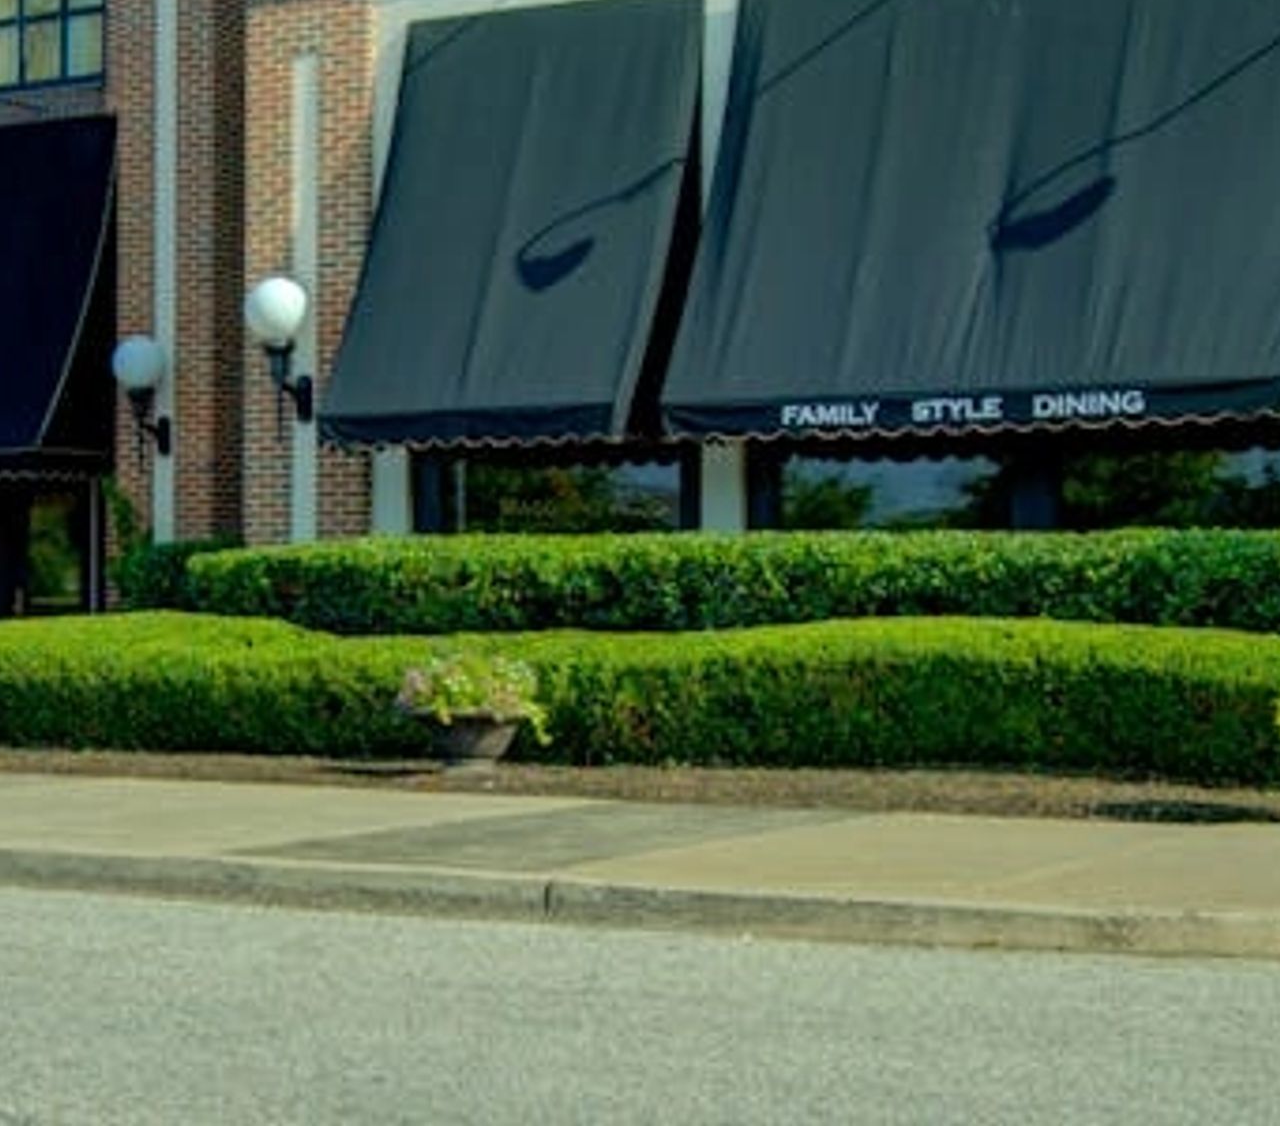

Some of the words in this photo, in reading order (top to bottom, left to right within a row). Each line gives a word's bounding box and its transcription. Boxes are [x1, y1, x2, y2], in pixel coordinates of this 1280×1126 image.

[780, 401, 880, 426] FAMILY
[912, 396, 1004, 422] STYLE
[1031, 389, 1146, 419] DINING
